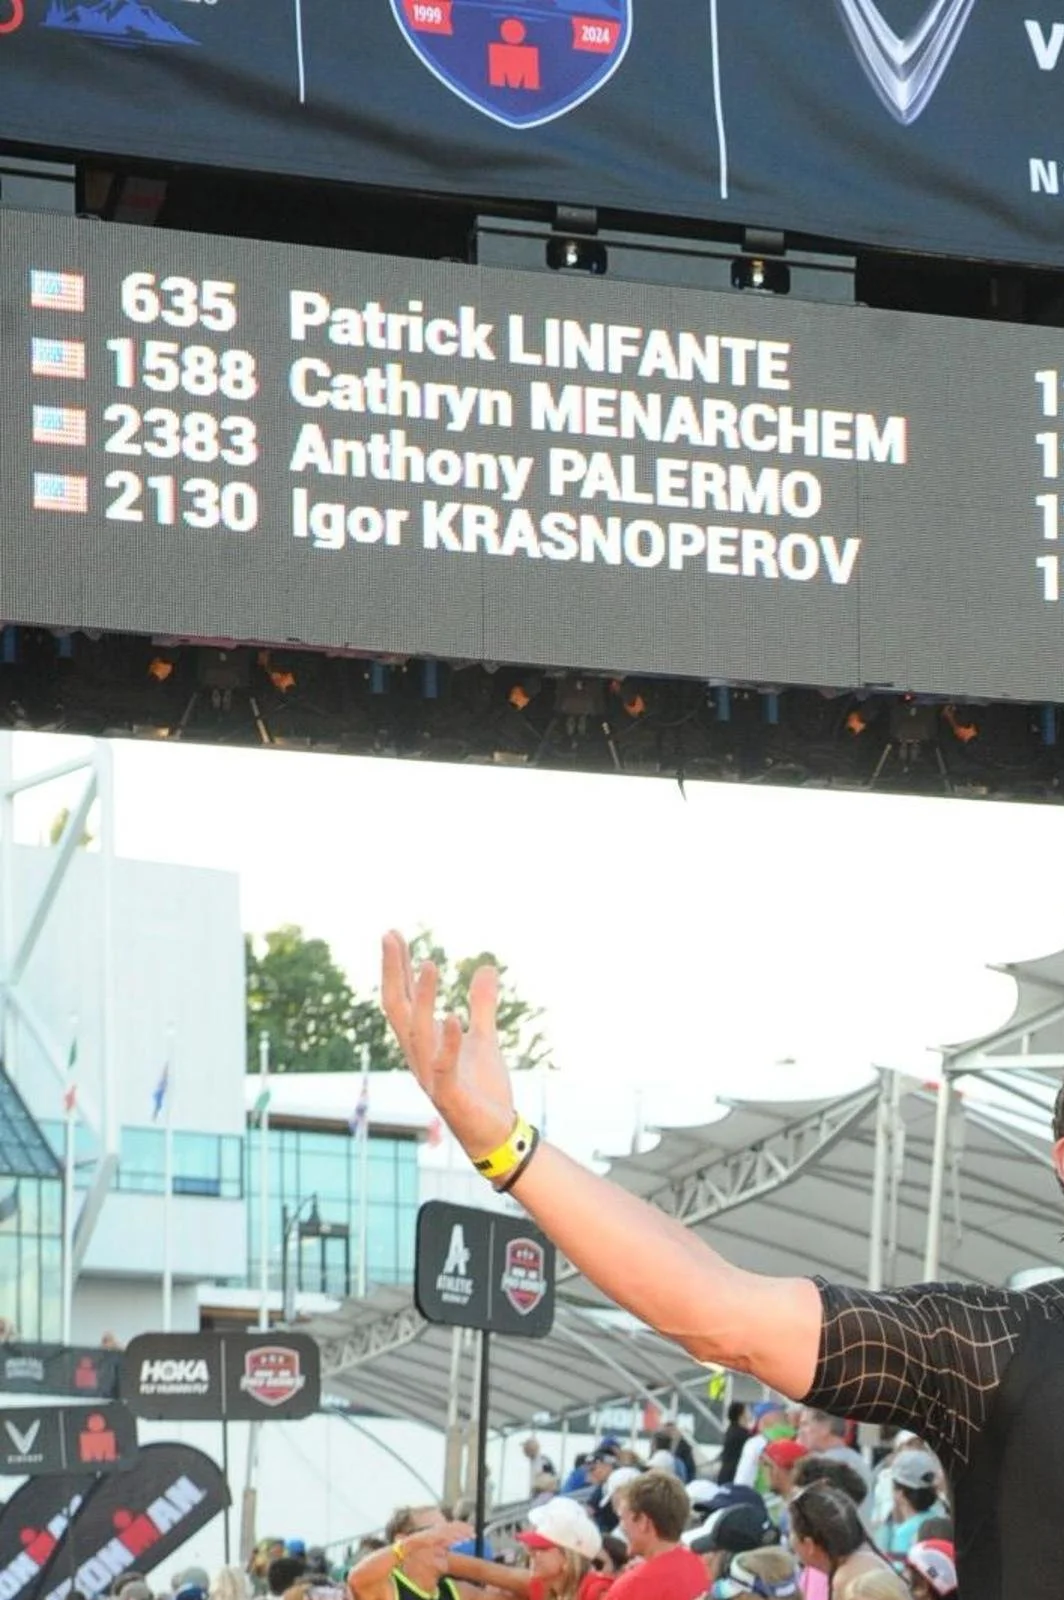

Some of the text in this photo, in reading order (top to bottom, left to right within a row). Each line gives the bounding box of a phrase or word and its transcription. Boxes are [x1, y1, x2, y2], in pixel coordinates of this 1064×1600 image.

[413, 4, 442, 24] 1999
[581, 25, 610, 43] 2024
[120, 272, 238, 332] 635
[290, 290, 494, 363] Patrick
[509, 314, 792, 390] LINFANTE
[106, 337, 258, 399] 1588
[289, 358, 514, 432] Cathryn
[531, 381, 908, 464] MENARCHEM
[104, 403, 258, 466] 2383
[289, 423, 534, 501] Anthony
[549, 448, 822, 519] PALERMO
[104, 470, 259, 533] 2130
[292, 488, 408, 550] Igor
[424, 501, 860, 585] KRASNOPEROV
[140, 1359, 209, 1382] HOKA
